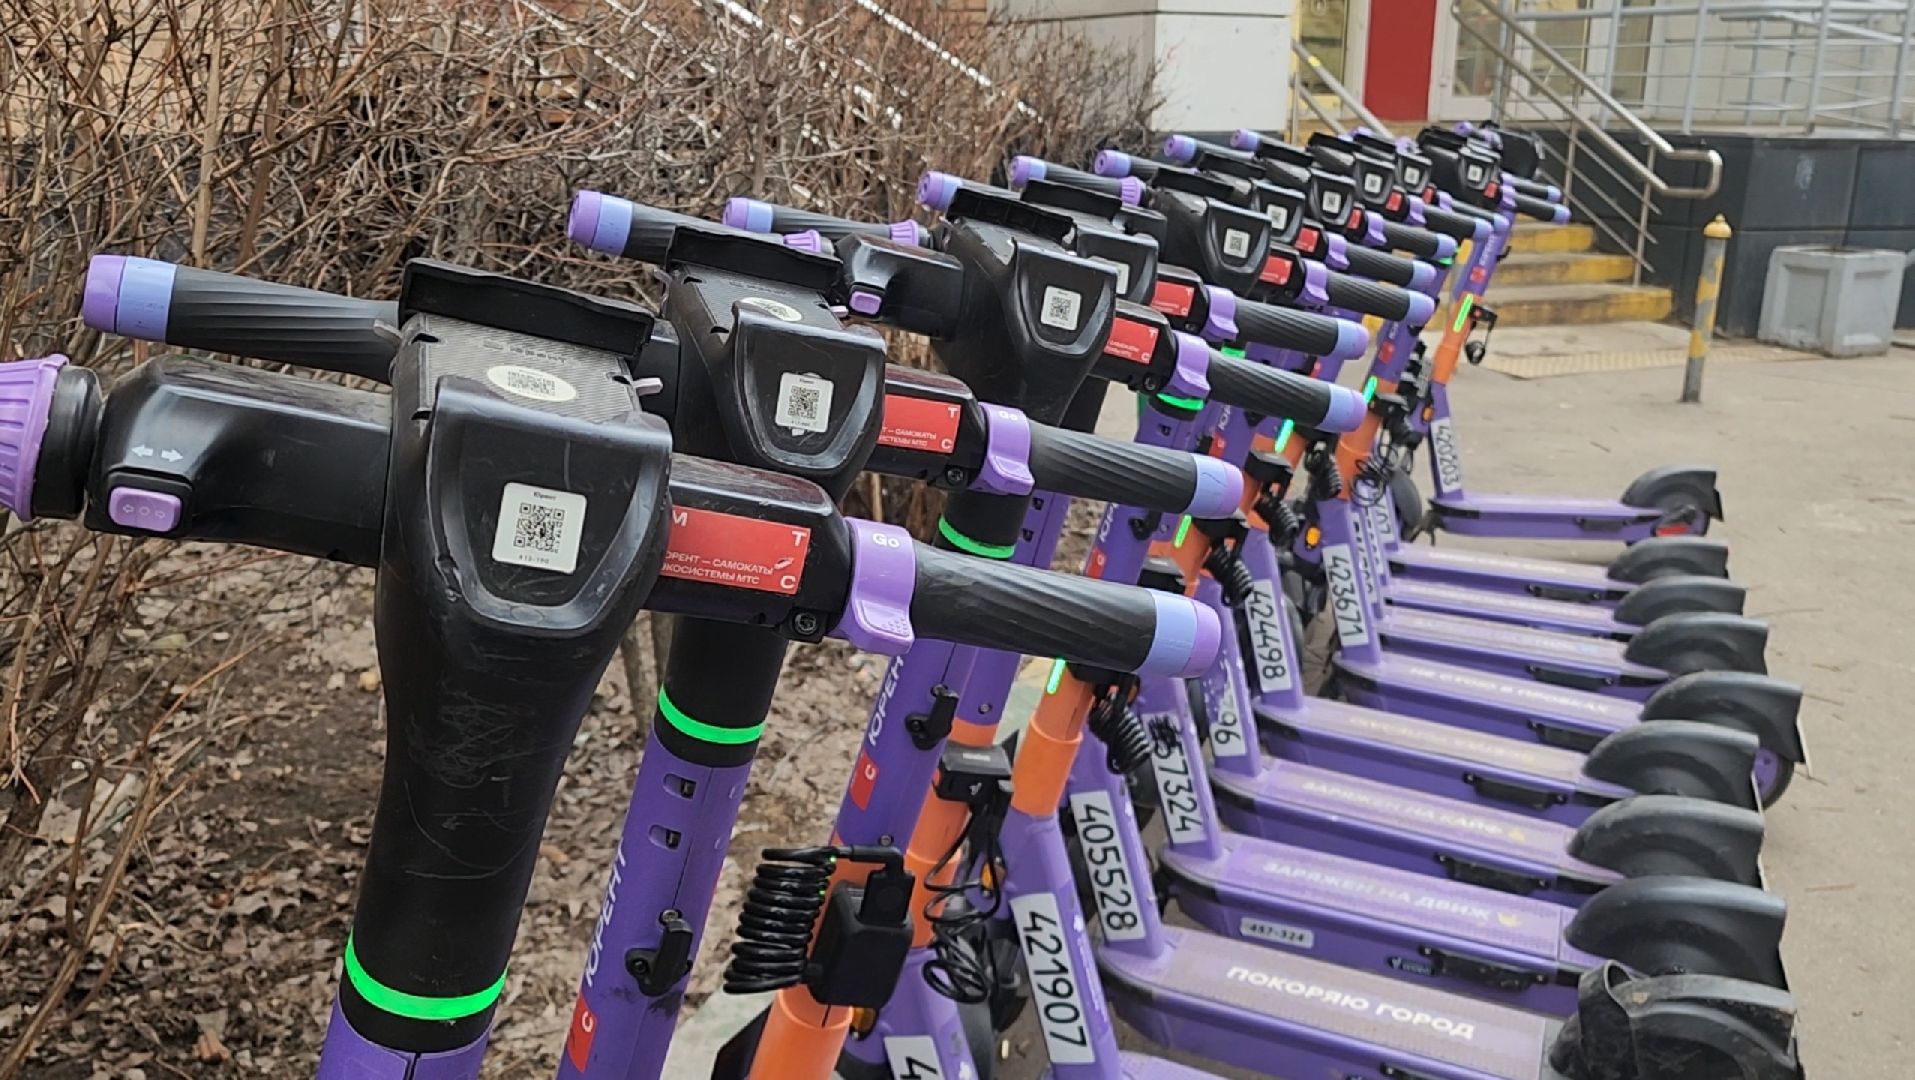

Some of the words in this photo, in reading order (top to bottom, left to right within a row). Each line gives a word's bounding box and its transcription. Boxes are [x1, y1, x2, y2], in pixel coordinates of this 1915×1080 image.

[712, 558, 774, 576] САМОКАТЫ
[736, 573, 760, 585] МТС
[792, 531, 808, 547] Т
[872, 533, 900, 548] Go
[1250, 590, 1286, 680] 424498
[1327, 555, 1363, 637] 423671
[868, 655, 904, 747] ЮРЕН
[1149, 715, 1203, 832] 57324
[1077, 804, 1138, 931] 405528
[1416, 896, 1492, 921] ДВИЖ
[585, 837, 627, 988] ЮРЕНТ
[1023, 911, 1088, 1047] 421907
[1226, 966, 1370, 1012] ПОКОРЯЮ
[1376, 1003, 1477, 1041] ГОРОД
